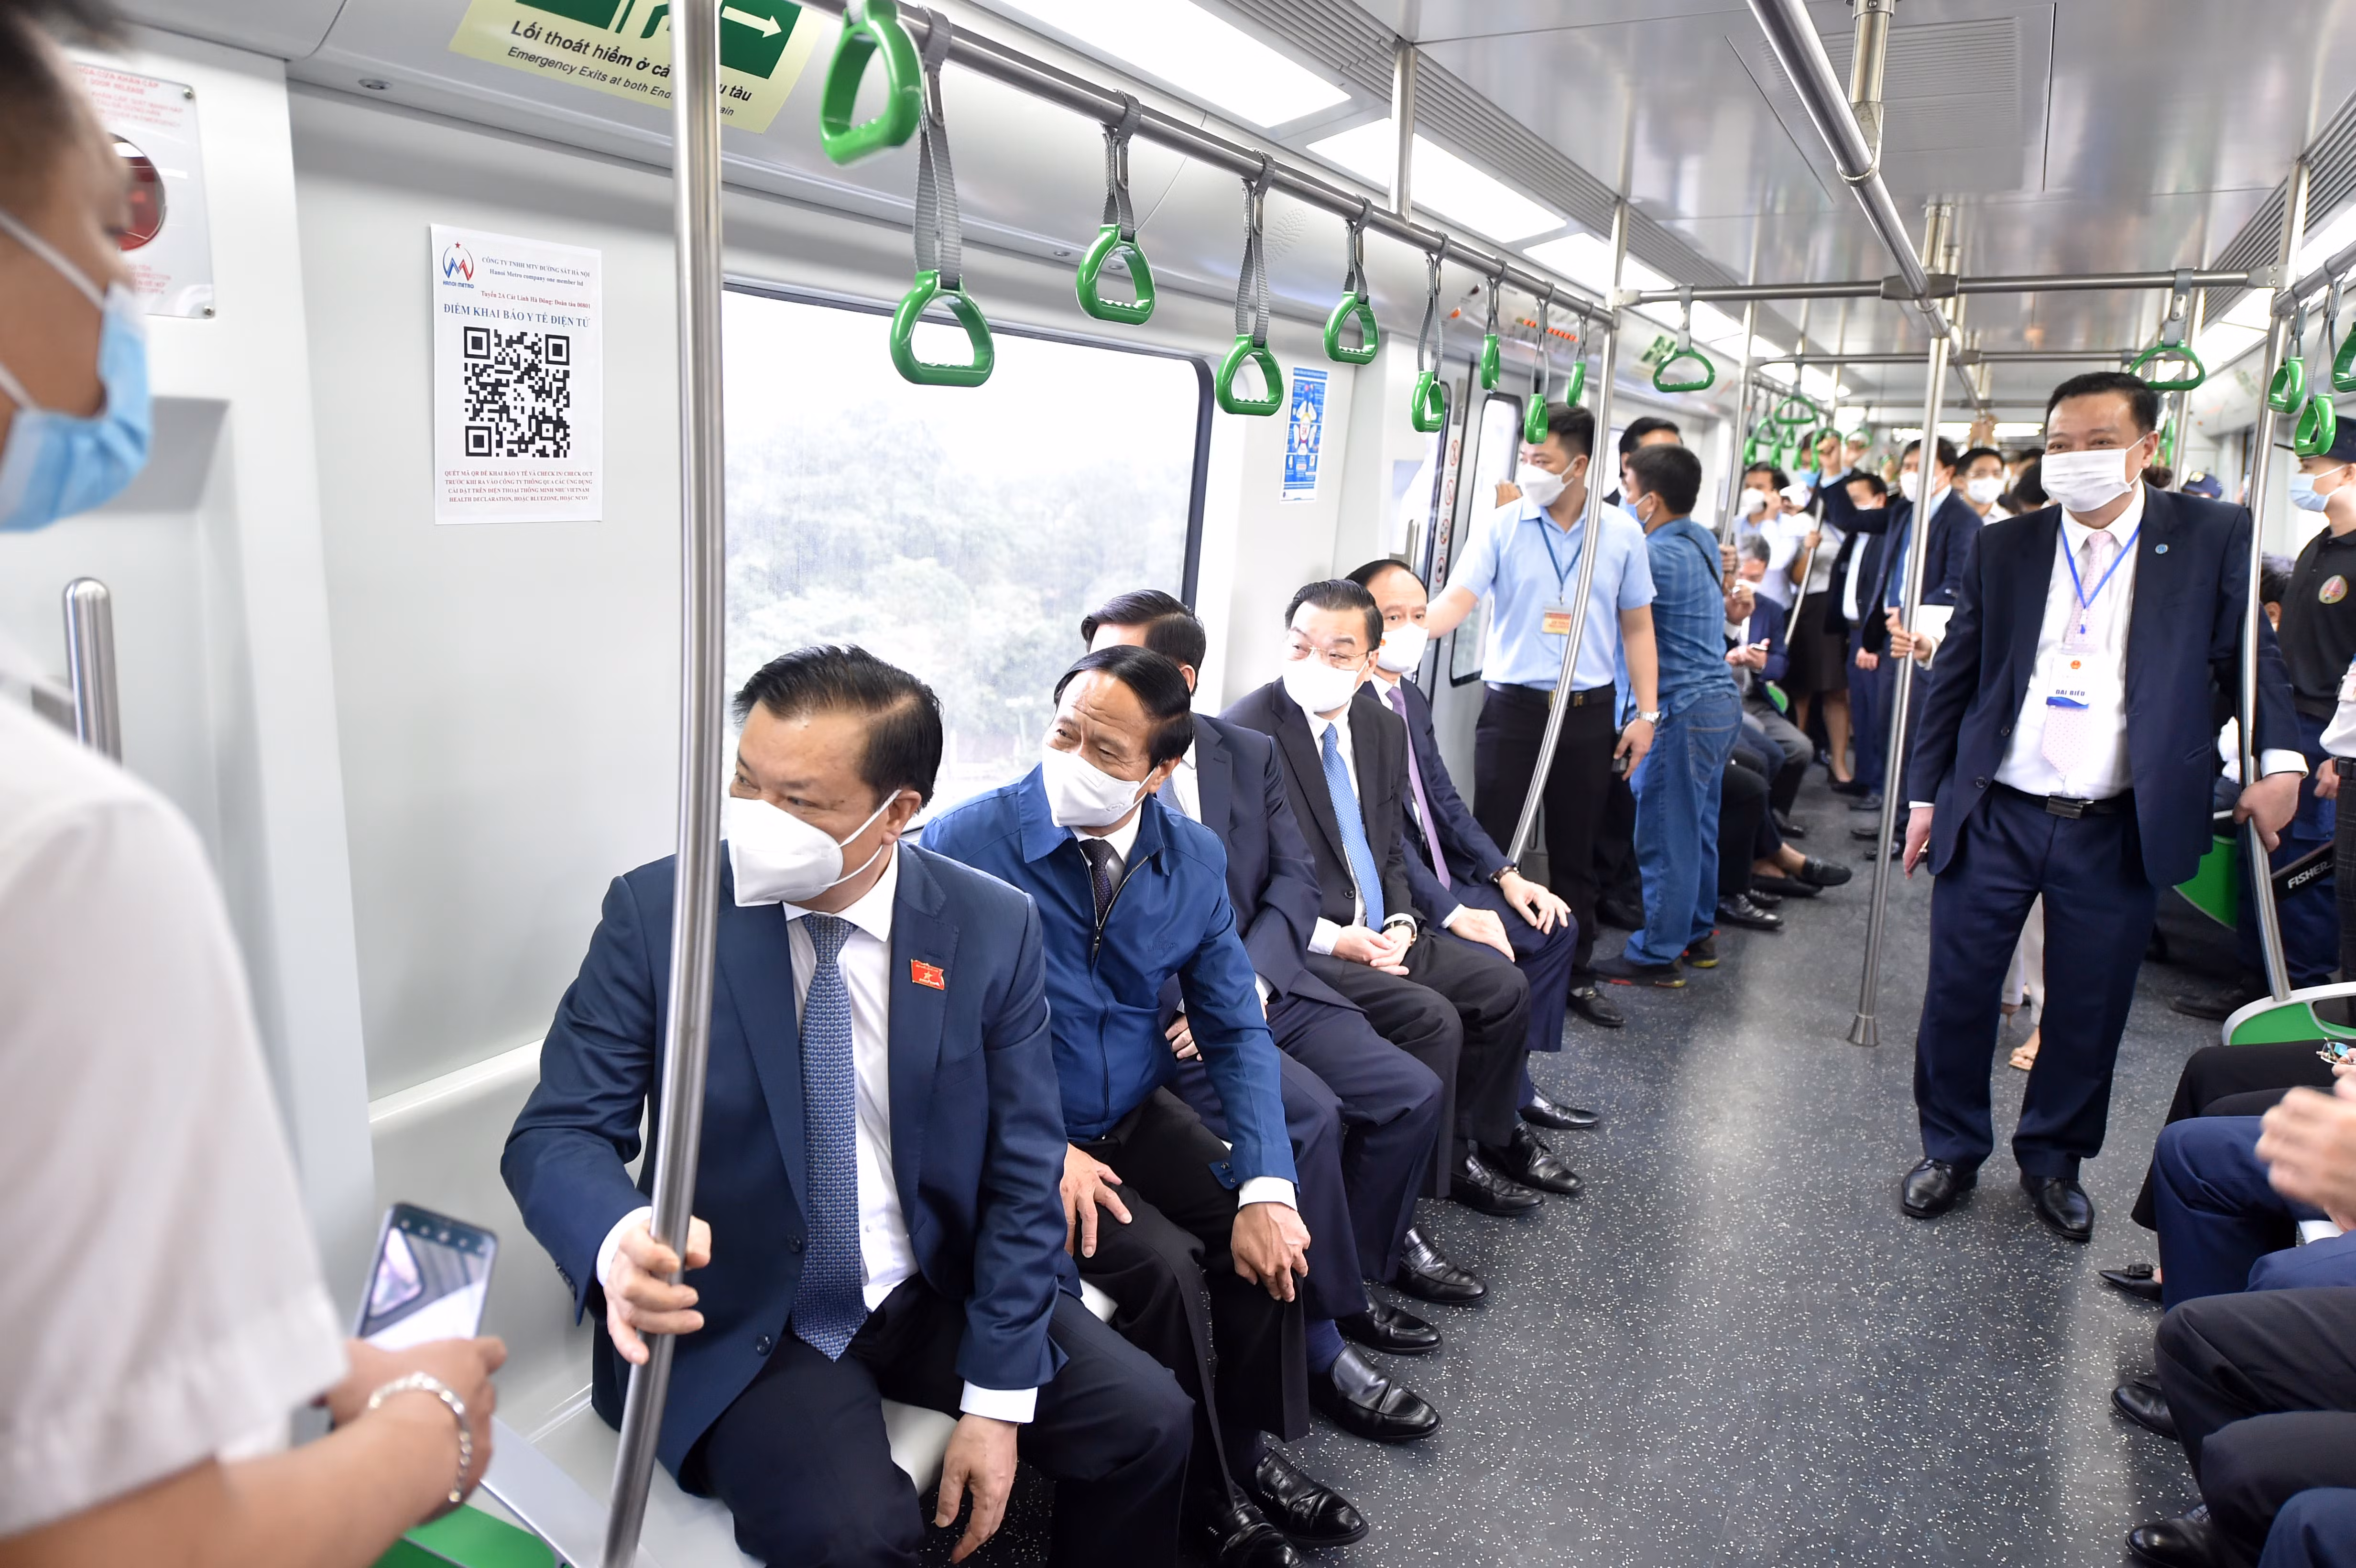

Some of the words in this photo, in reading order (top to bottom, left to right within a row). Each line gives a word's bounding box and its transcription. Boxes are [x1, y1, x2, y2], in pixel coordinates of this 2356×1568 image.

[511, 20, 543, 40] Lối
[545, 31, 590, 54] thoát
[592, 44, 633, 67] hiểm
[636, 57, 650, 70] ở
[652, 64, 671, 77] cả
[729, 85, 752, 101] tàu
[508, 46, 577, 75] Emergency
[579, 66, 608, 82] Exits
[610, 76, 622, 85] at
[623, 78, 648, 92] both
[650, 86, 673, 99] End
[720, 106, 734, 116] ain
[482, 256, 499, 264] CÔNG
[523, 274, 545, 283] company
[480, 290, 497, 298] Tuyến
[444, 303, 469, 316] ĐIỂM
[473, 306, 500, 318] KHAI
[503, 308, 524, 321] BÁO
[527, 312, 533, 322] Y
[535, 312, 548, 323] TẾ
[551, 315, 574, 327] ĐIỆN
[576, 316, 590, 327] TỬ
[2288, 861, 2333, 889] FISHER
